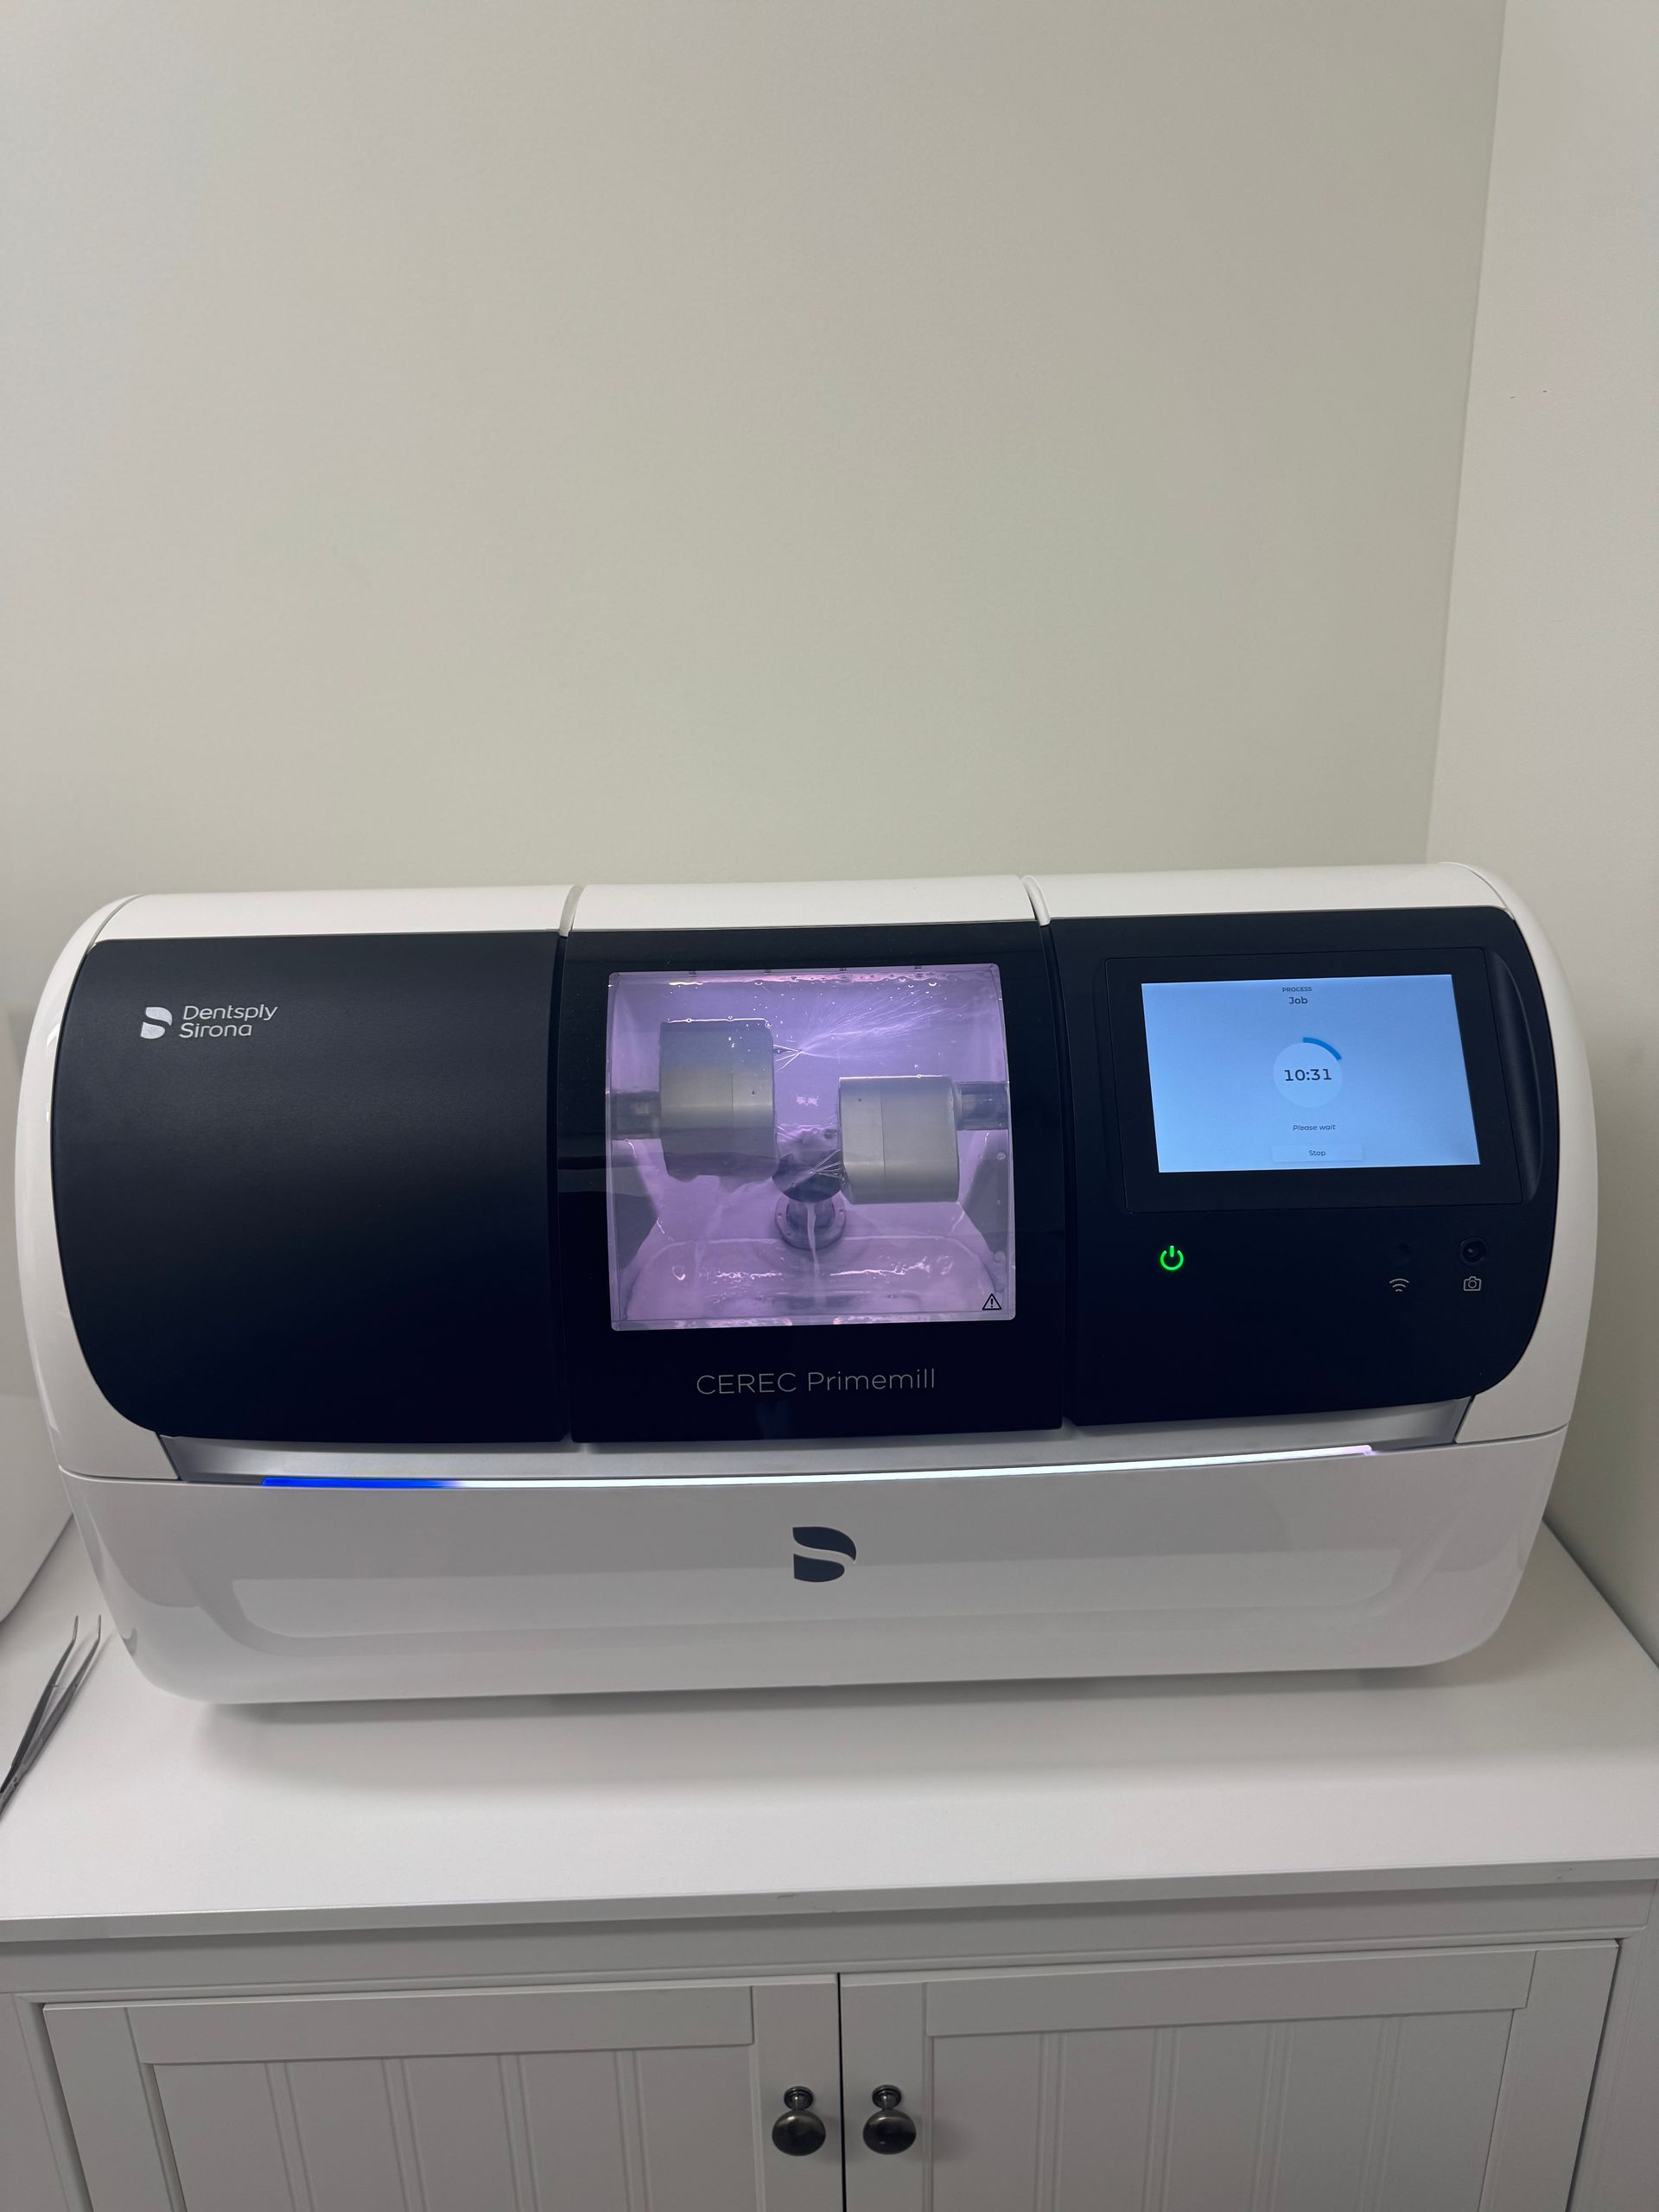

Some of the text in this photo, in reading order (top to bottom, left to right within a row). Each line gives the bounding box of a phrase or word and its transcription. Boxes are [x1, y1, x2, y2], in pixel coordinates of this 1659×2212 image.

[182, 1004, 278, 1021] Dentsply
[179, 1022, 253, 1039] Sirona
[1284, 1068, 1332, 1082] 10:31
[696, 1368, 936, 1395] CEREC Primemill
